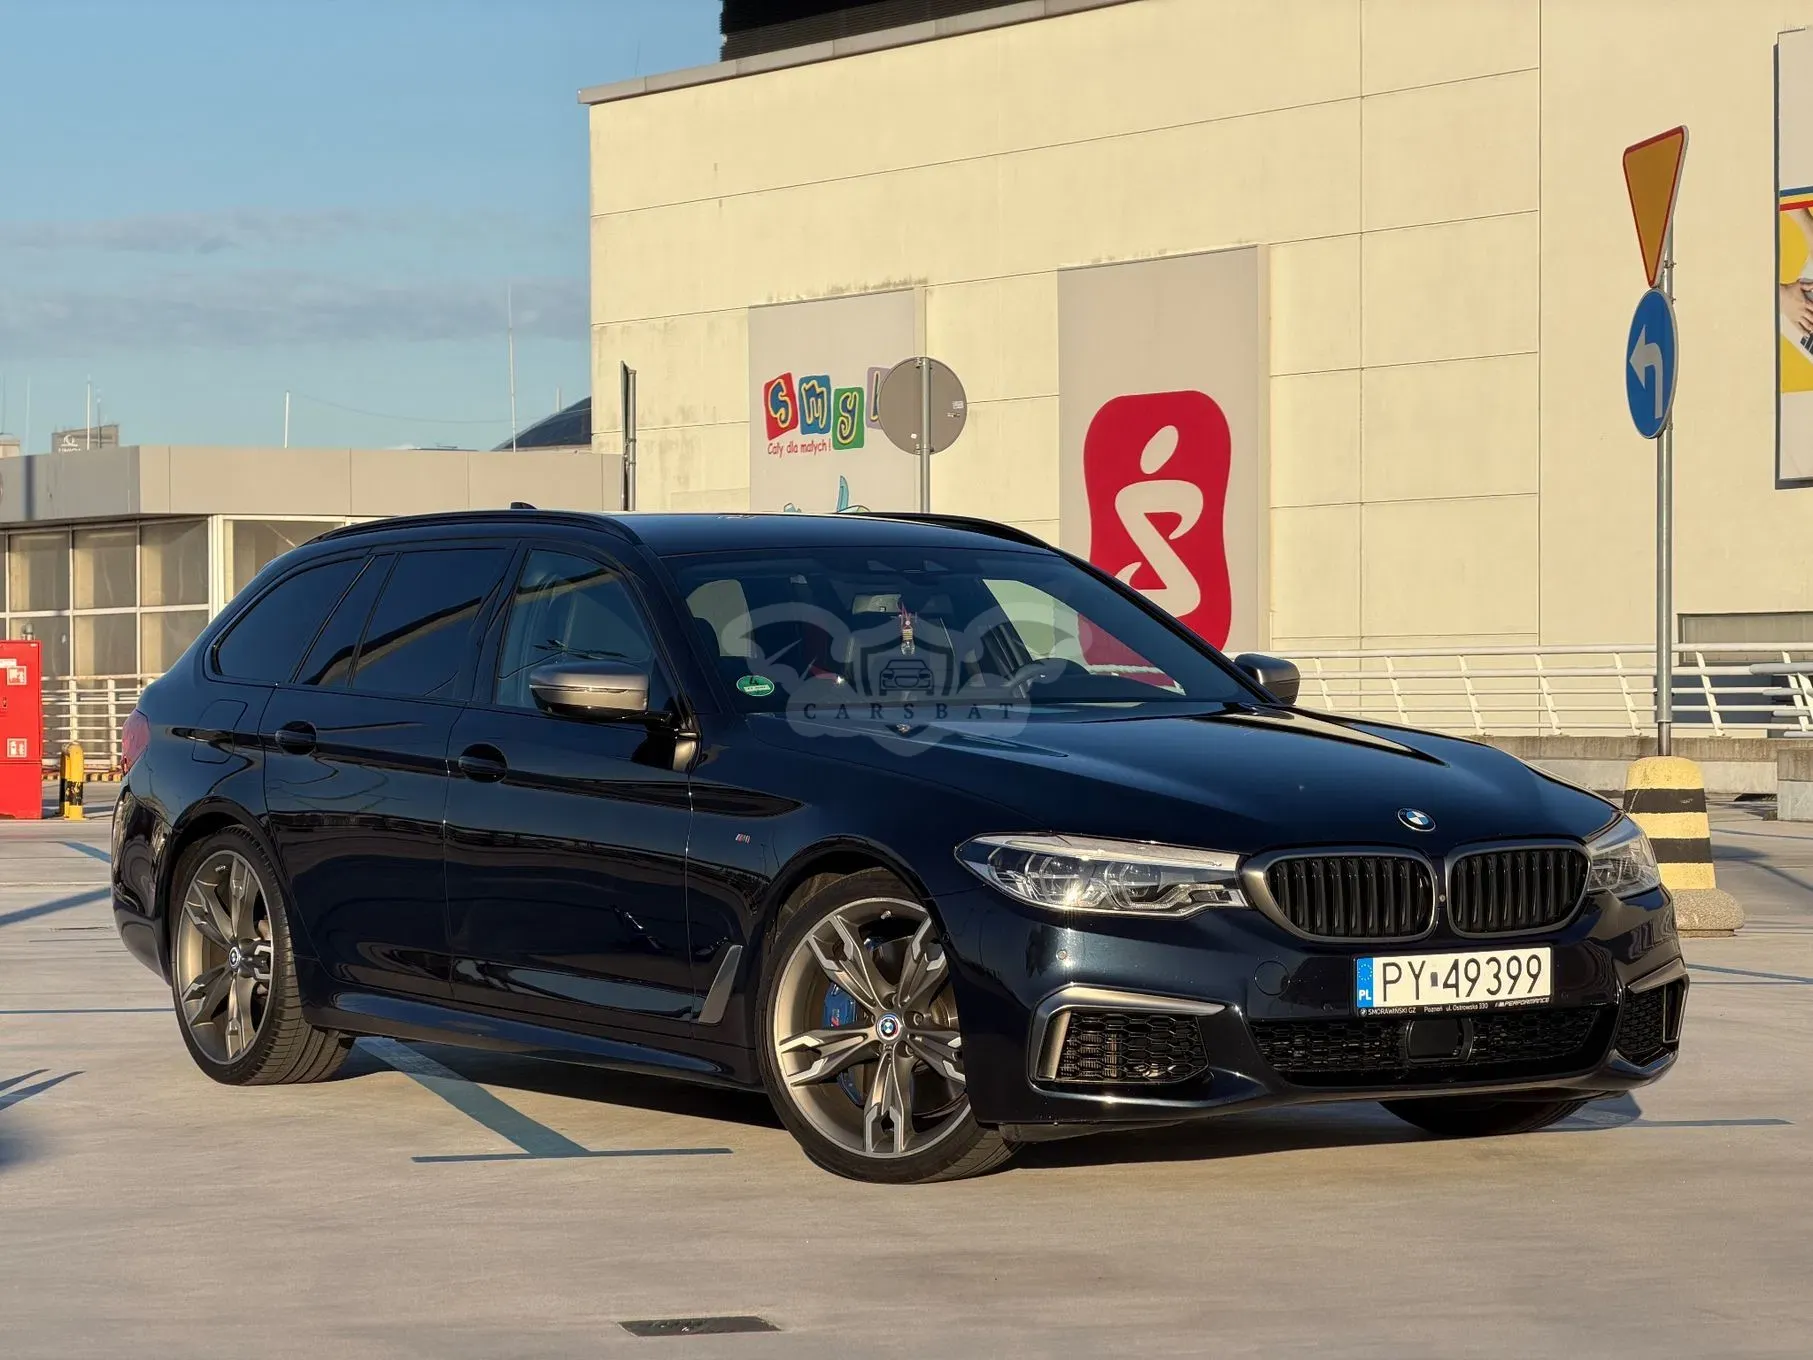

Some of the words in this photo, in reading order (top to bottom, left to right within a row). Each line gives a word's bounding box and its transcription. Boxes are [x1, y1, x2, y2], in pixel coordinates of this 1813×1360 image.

[786, 440, 798, 454] dla
[1382, 960, 1426, 1002] PY
[1443, 953, 1542, 998] 49399
[1359, 989, 1372, 1001] PL
